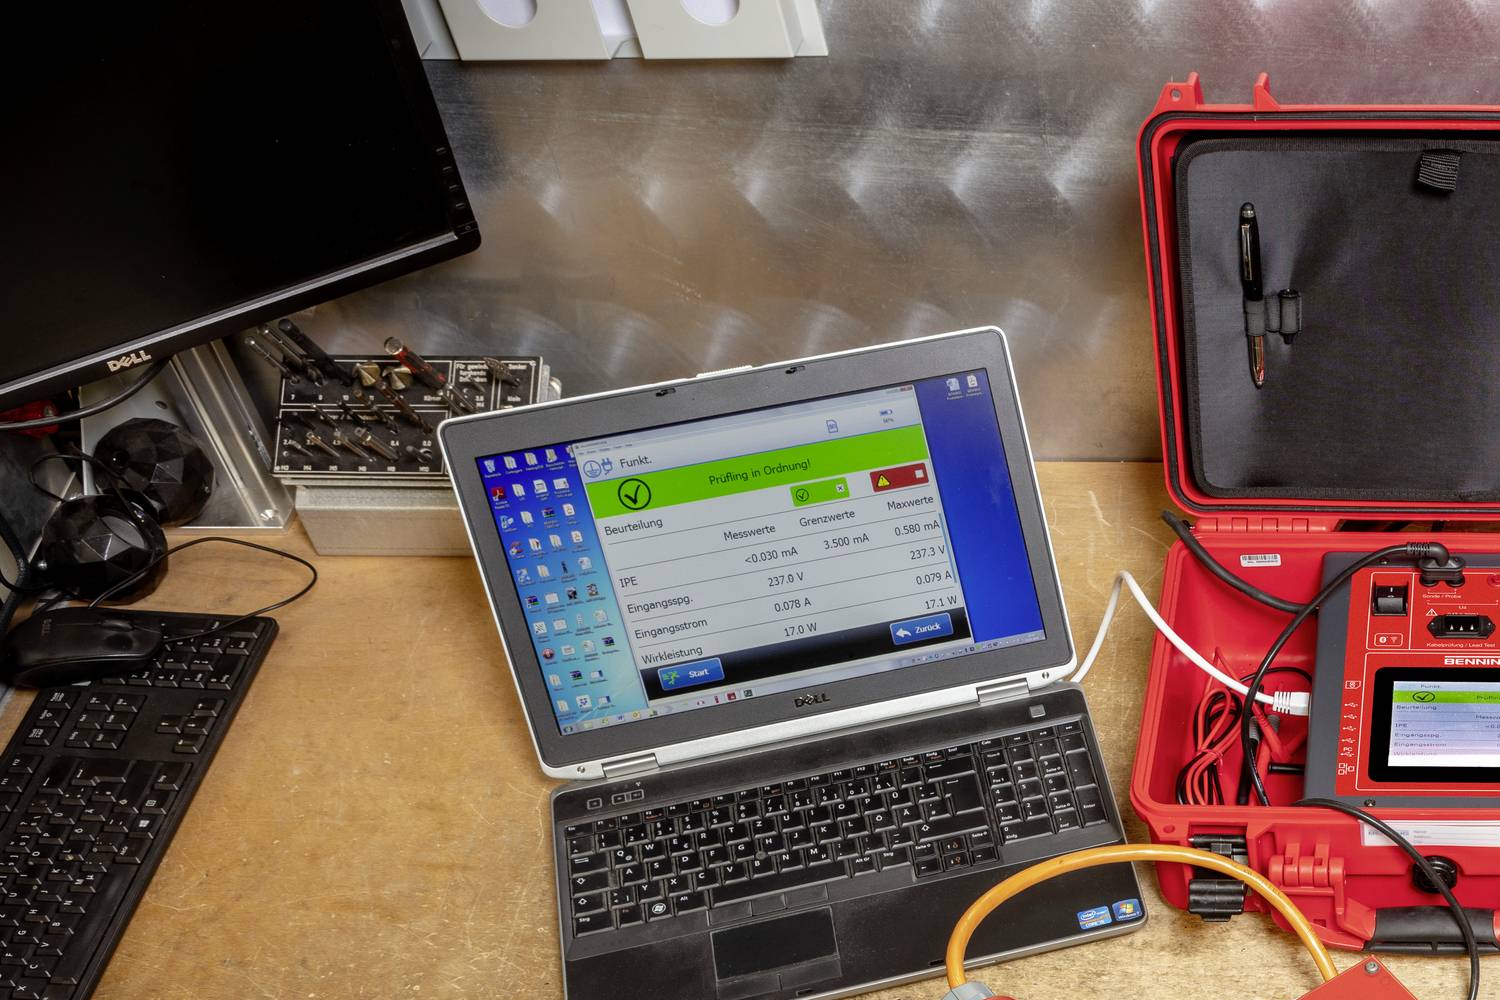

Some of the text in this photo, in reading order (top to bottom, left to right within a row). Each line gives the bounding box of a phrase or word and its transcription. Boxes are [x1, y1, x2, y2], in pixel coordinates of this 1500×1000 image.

[106, 350, 152, 372] DELL
[619, 455, 653, 469] Funkt.
[709, 459, 811, 486] Prüfling in Ordnung!
[604, 518, 663, 536] Beurteilung
[723, 495, 934, 542] Messwerte Grenzwerte Maxwerte
[619, 576, 638, 589] IPE
[744, 549, 778, 565] <0.030
[780, 547, 799, 559] mA
[823, 536, 850, 550] 3.500
[853, 533, 870, 545] mA
[894, 523, 921, 537] 0.580
[923, 520, 941, 531] mA
[627, 544, 946, 615] Eingangsspg. 237.0 V 237.3 V
[634, 570, 953, 640] Eingangsstrom 0.078 A 0.079 A
[641, 595, 958, 665] Wirkleistung 17.0 W 17.1 W
[914, 621, 942, 635] Zurück
[688, 668, 710, 680] Start
[794, 692, 830, 709] DELL
